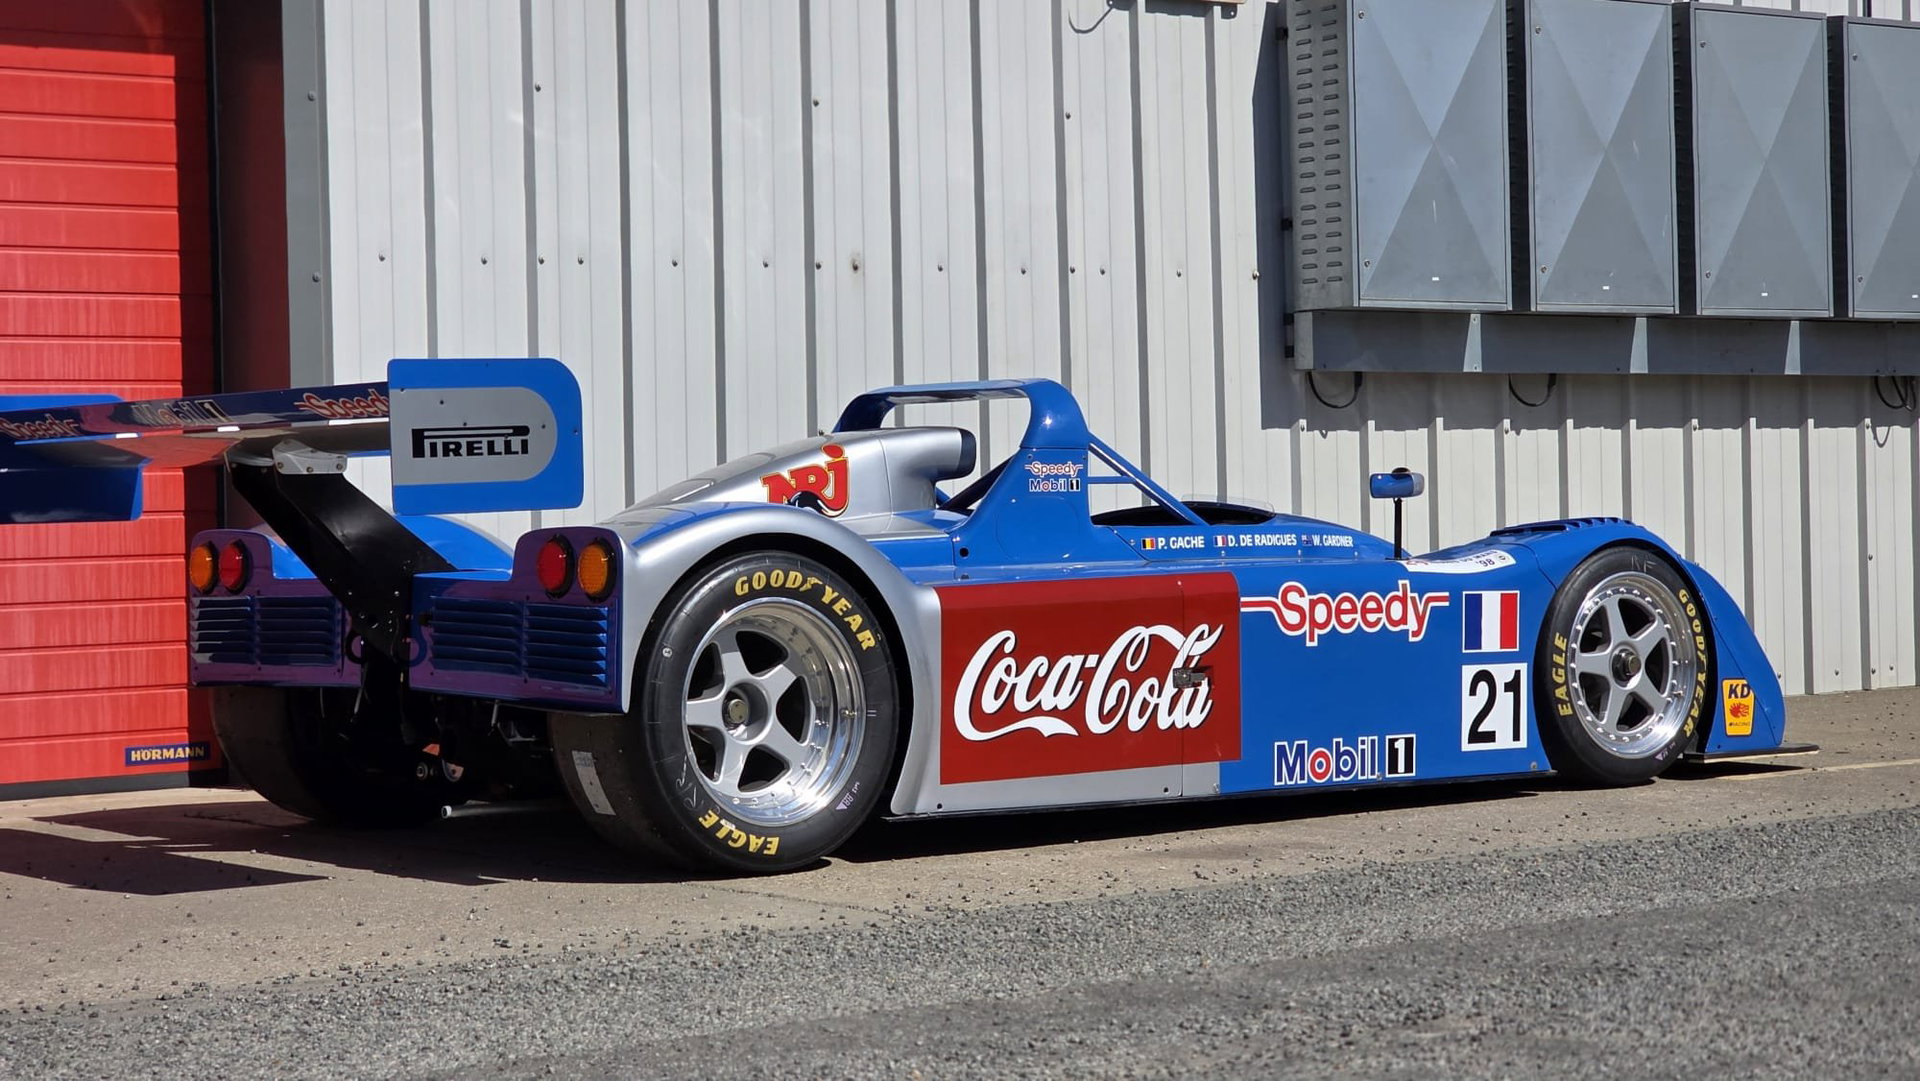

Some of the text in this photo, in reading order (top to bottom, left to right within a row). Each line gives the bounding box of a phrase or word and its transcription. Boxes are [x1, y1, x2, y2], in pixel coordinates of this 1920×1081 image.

[294, 389, 390, 418] Speed
[411, 425, 530, 459] PIRELLI
[1028, 461, 1081, 477] Speedy
[1029, 478, 1080, 492] Mobil 1
[1158, 535, 1205, 550] P. GACHE
[1227, 534, 1298, 547] D. DE RADIGUES
[1323, 535, 1354, 548] GARDNER
[1270, 580, 1443, 647] Speedy
[953, 623, 1224, 742] Coca-Cola
[1552, 632, 1574, 717] EAGLE
[1728, 683, 1751, 699] KD
[1467, 669, 1522, 744] 21
[131, 747, 205, 762] HÖRMANN
[1274, 736, 1379, 786] Mobil
[698, 810, 780, 855] EAGLE
